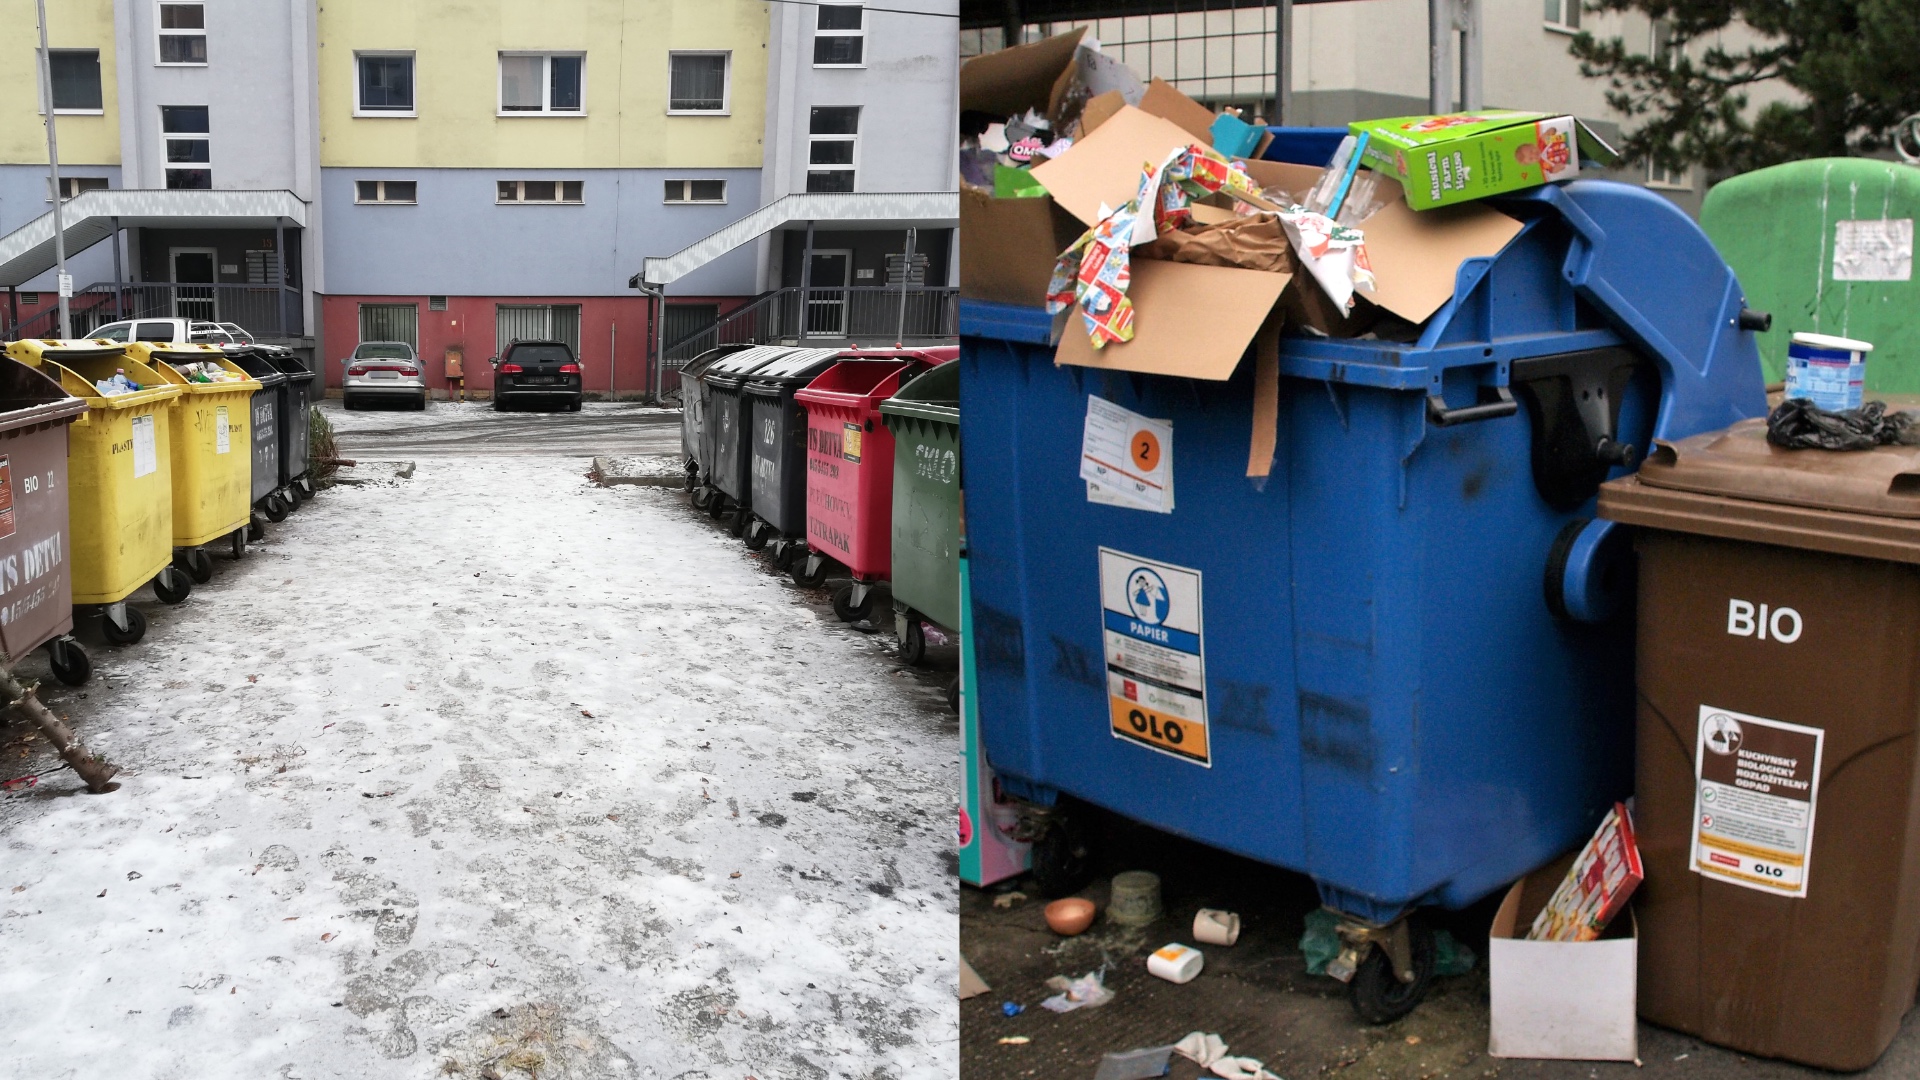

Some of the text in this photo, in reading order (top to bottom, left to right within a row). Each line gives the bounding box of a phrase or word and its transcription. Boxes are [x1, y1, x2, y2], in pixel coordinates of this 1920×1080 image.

[1427, 151, 1441, 201] Musical
[1441, 156, 1452, 190] Farm
[1453, 151, 1465, 190] House
[1140, 441, 1150, 460] 2
[24, 475, 39, 494] BIO
[809, 516, 850, 554] TETRAPAK
[23, 531, 62, 585] DETVA
[1130, 621, 1169, 643] PAPIER
[1727, 598, 1803, 644] BIO
[1129, 709, 1183, 745] OLO
[1735, 778, 1771, 793] ODPAD
[1754, 863, 1783, 877] OLO
